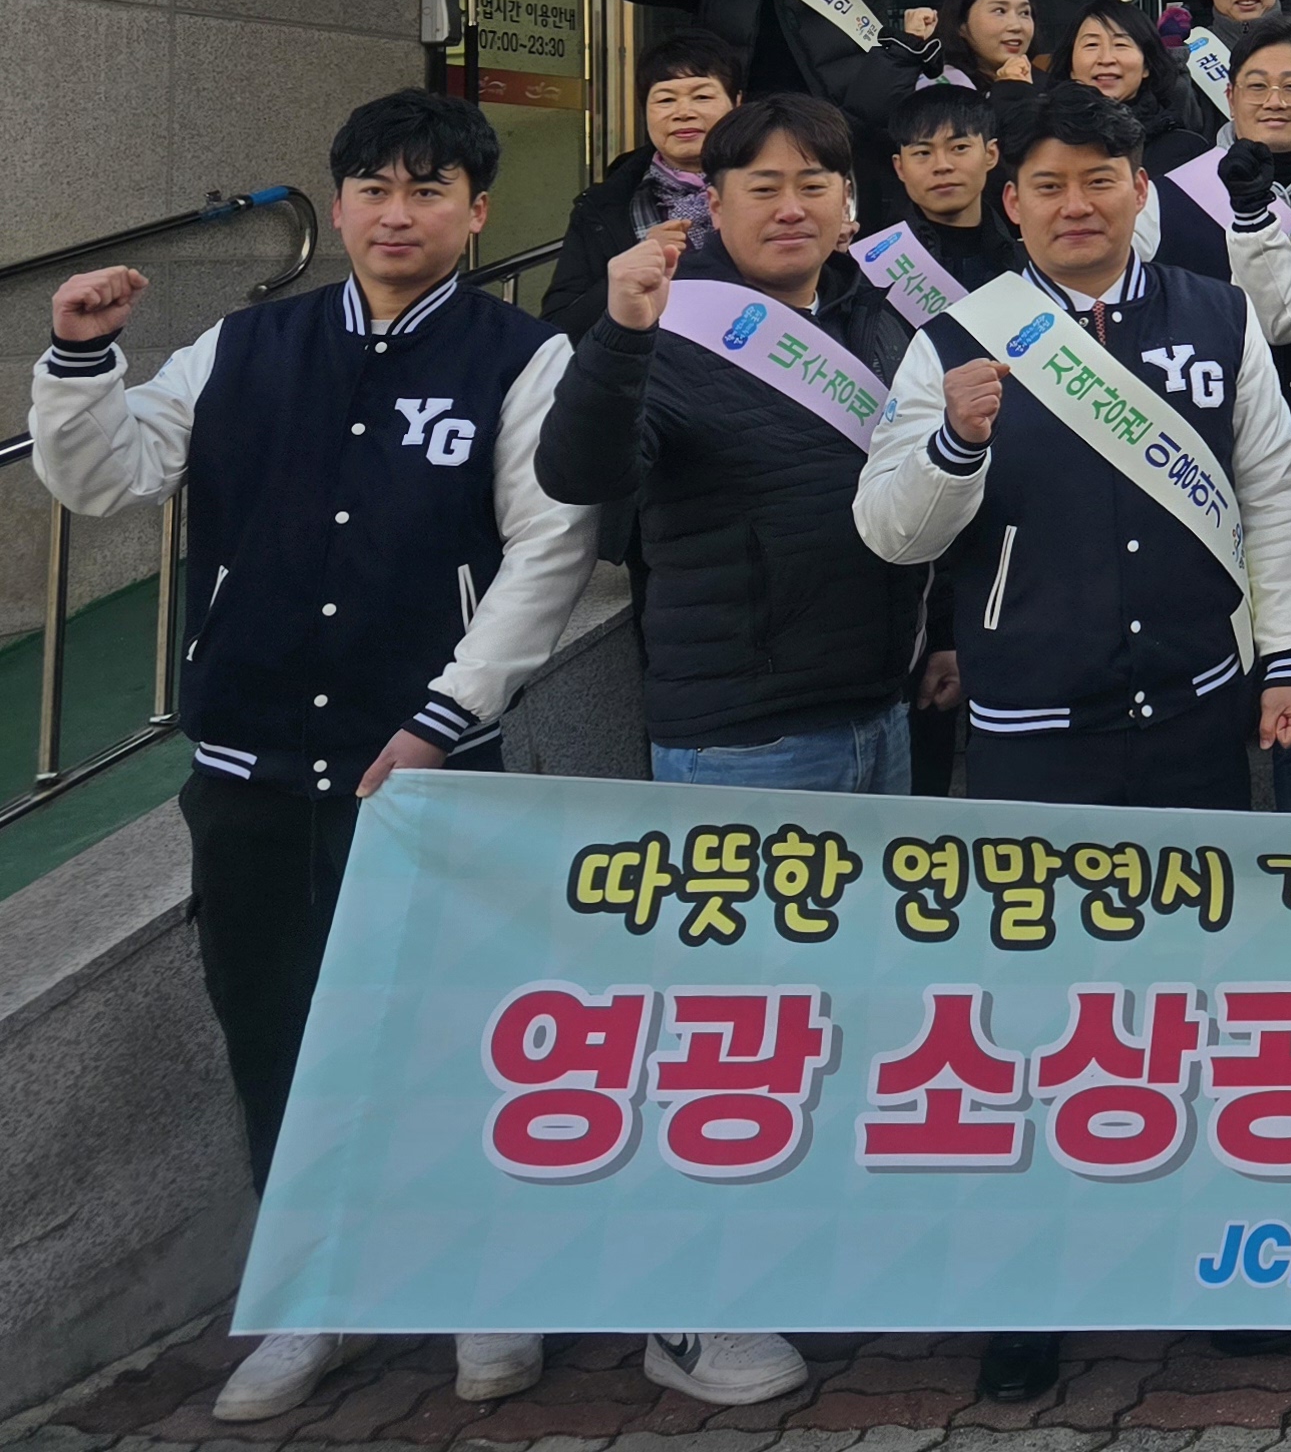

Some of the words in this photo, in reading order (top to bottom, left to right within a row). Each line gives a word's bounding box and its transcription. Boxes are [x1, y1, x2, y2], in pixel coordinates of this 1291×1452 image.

[480, 29, 565, 57] 07:00~23:30
[525, 3, 576, 30] 이용안내
[886, 253, 952, 315] 내수경
[767, 332, 879, 427] 내수경제
[1042, 345, 1154, 446] 지역상권
[1144, 431, 1228, 528] 이용하기
[571, 824, 858, 945] 따뜻한
[881, 834, 1233, 950] 연말연시
[489, 990, 825, 1167] 영광
